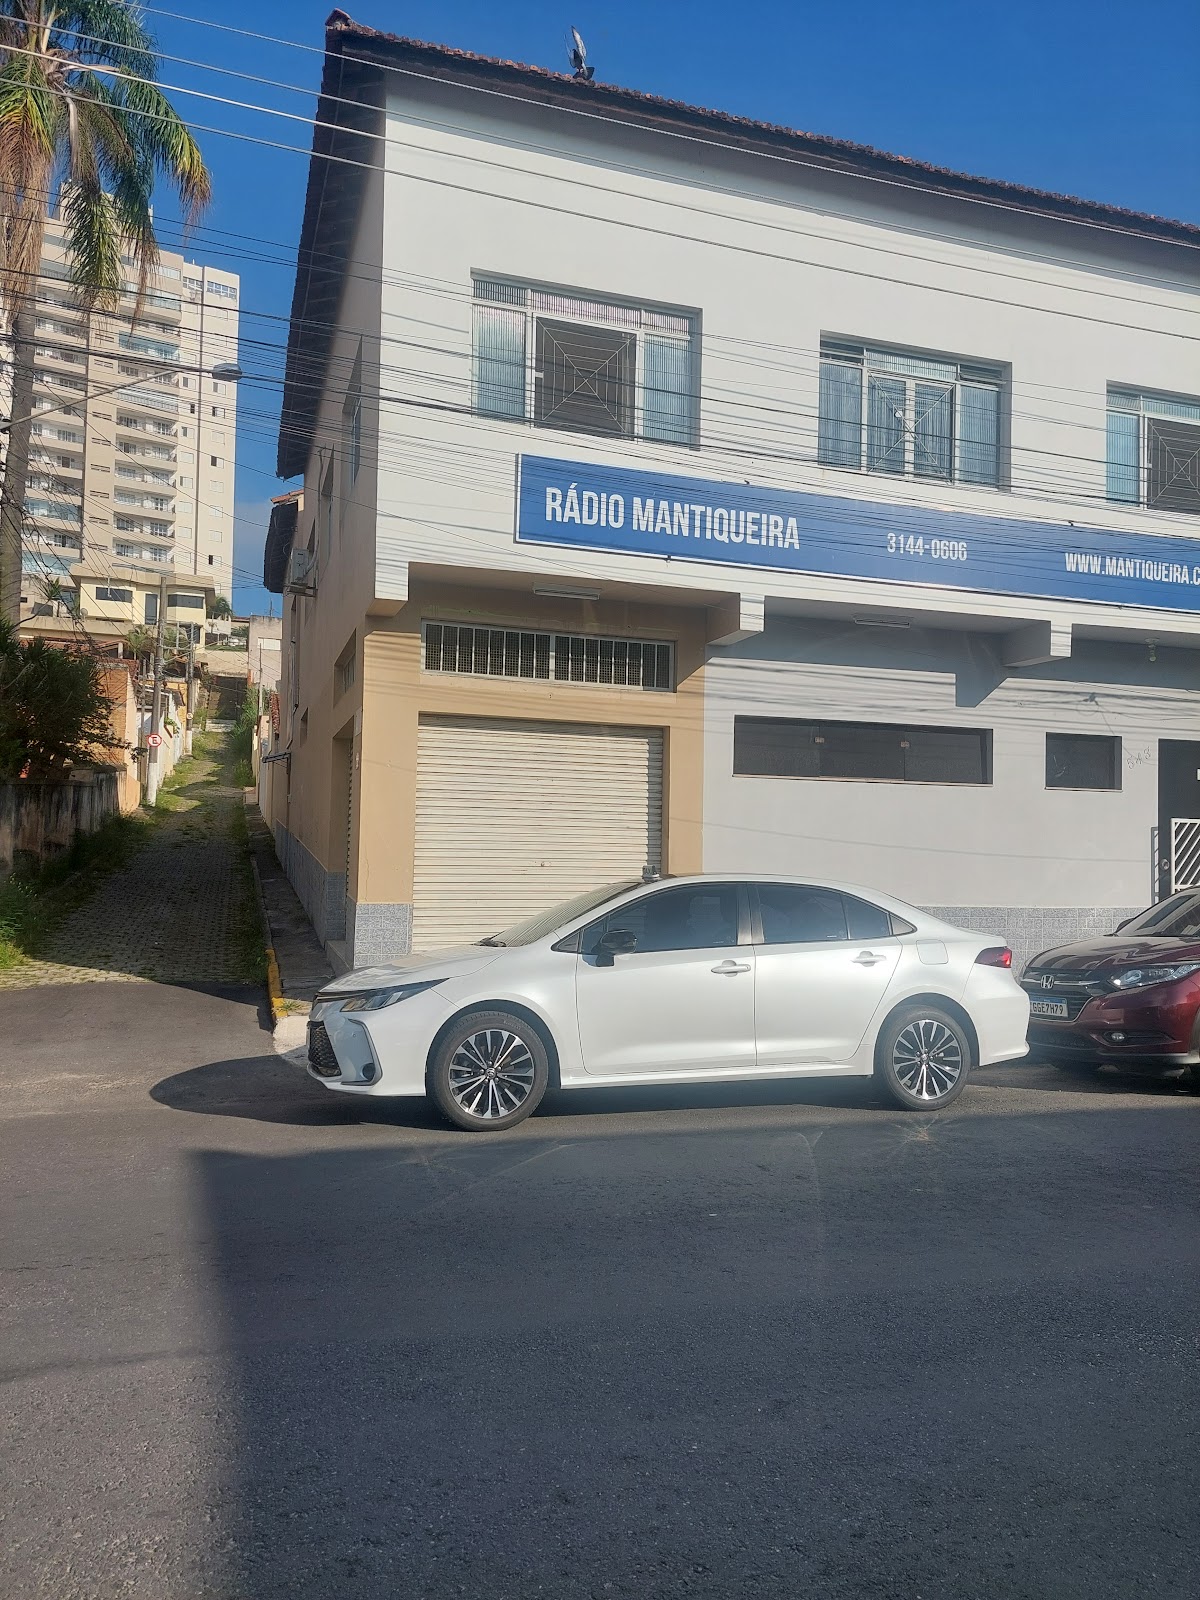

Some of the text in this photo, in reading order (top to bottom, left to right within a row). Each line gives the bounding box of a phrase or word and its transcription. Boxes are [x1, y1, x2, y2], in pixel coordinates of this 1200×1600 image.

[545, 482, 800, 549] RÁDIO MANTIQUEIRA
[887, 532, 968, 561] 3144-0606
[1032, 1001, 1064, 1015] GGE7H79
